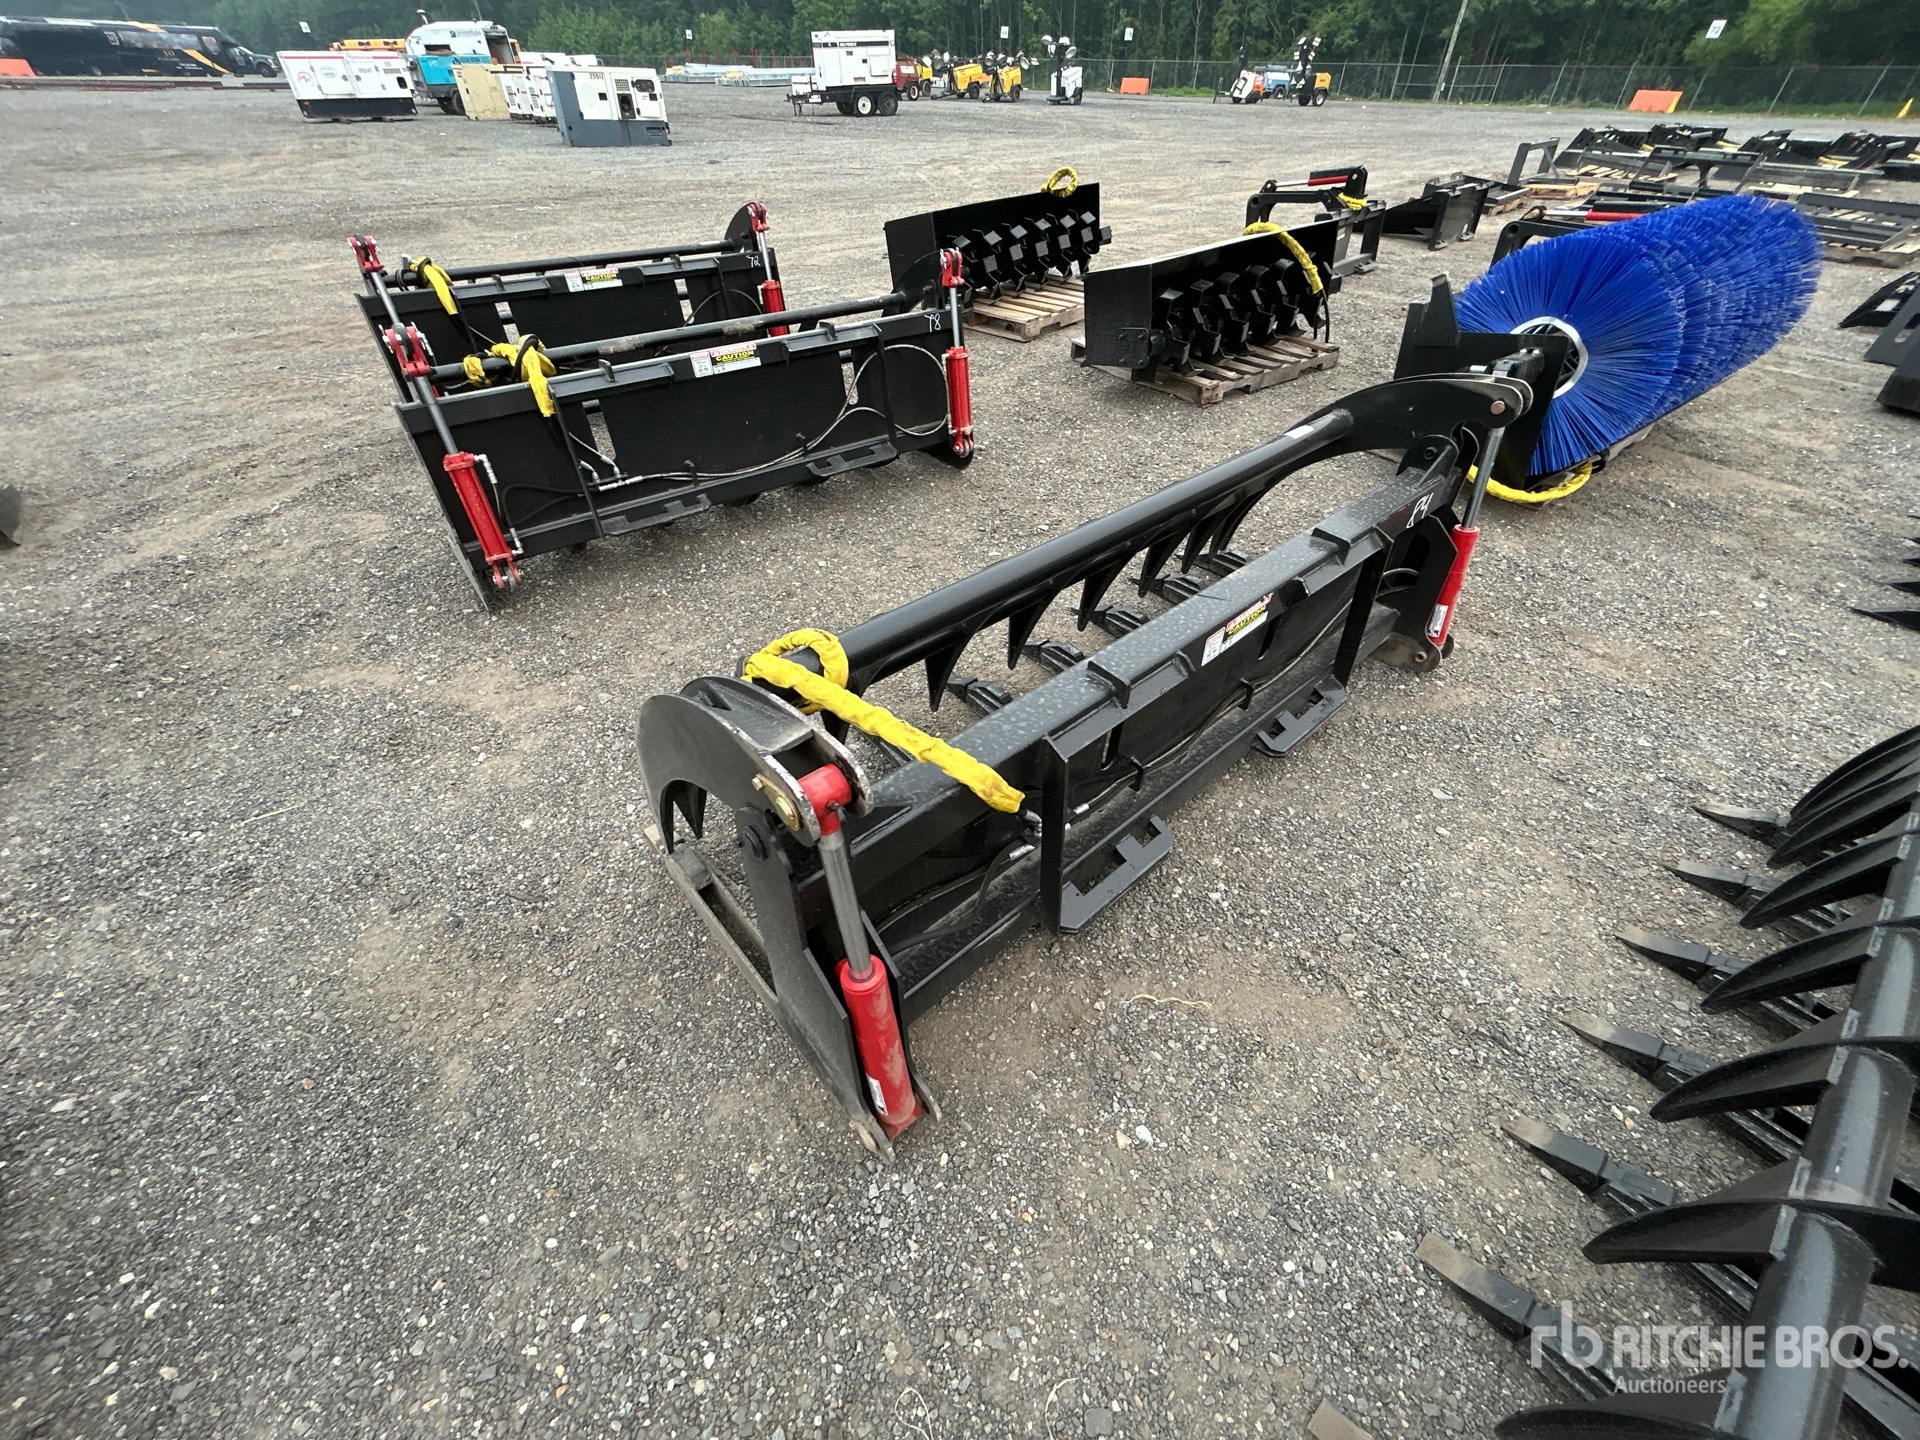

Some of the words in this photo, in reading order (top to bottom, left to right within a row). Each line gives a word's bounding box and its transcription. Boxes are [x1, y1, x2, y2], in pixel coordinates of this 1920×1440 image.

[585, 273, 617, 281] CAUTION
[715, 350, 754, 362] CAUTION
[1228, 604, 1267, 635] CAUTION
